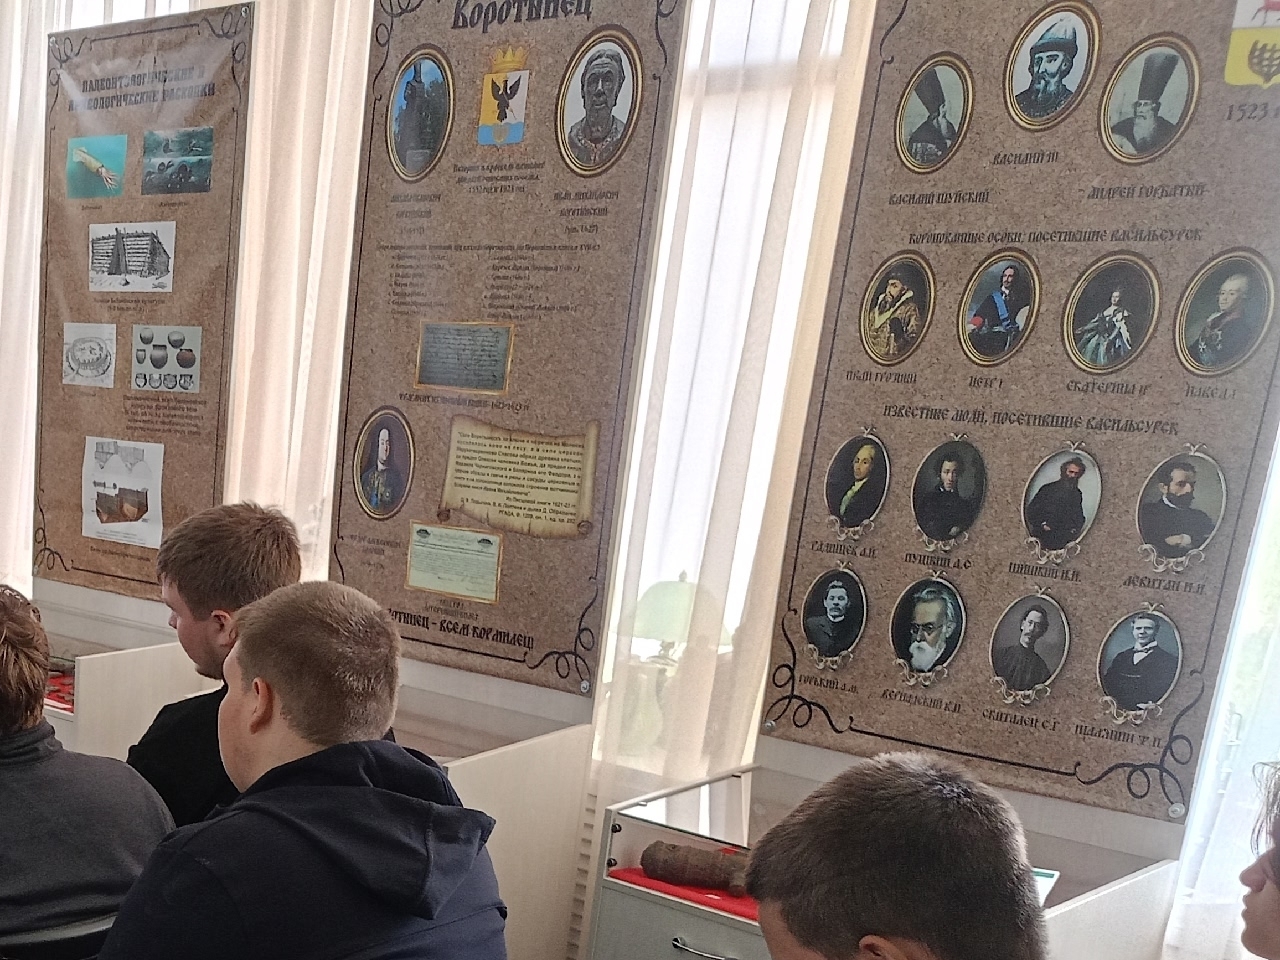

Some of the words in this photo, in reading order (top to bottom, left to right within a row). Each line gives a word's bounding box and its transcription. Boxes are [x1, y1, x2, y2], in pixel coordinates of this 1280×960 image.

[69, 91, 157, 111] АЕОЛОГИЧЕСКИЕ
[1226, 103, 1268, 122] 1523
[388, 608, 430, 630] ОТЫНЕЦ
